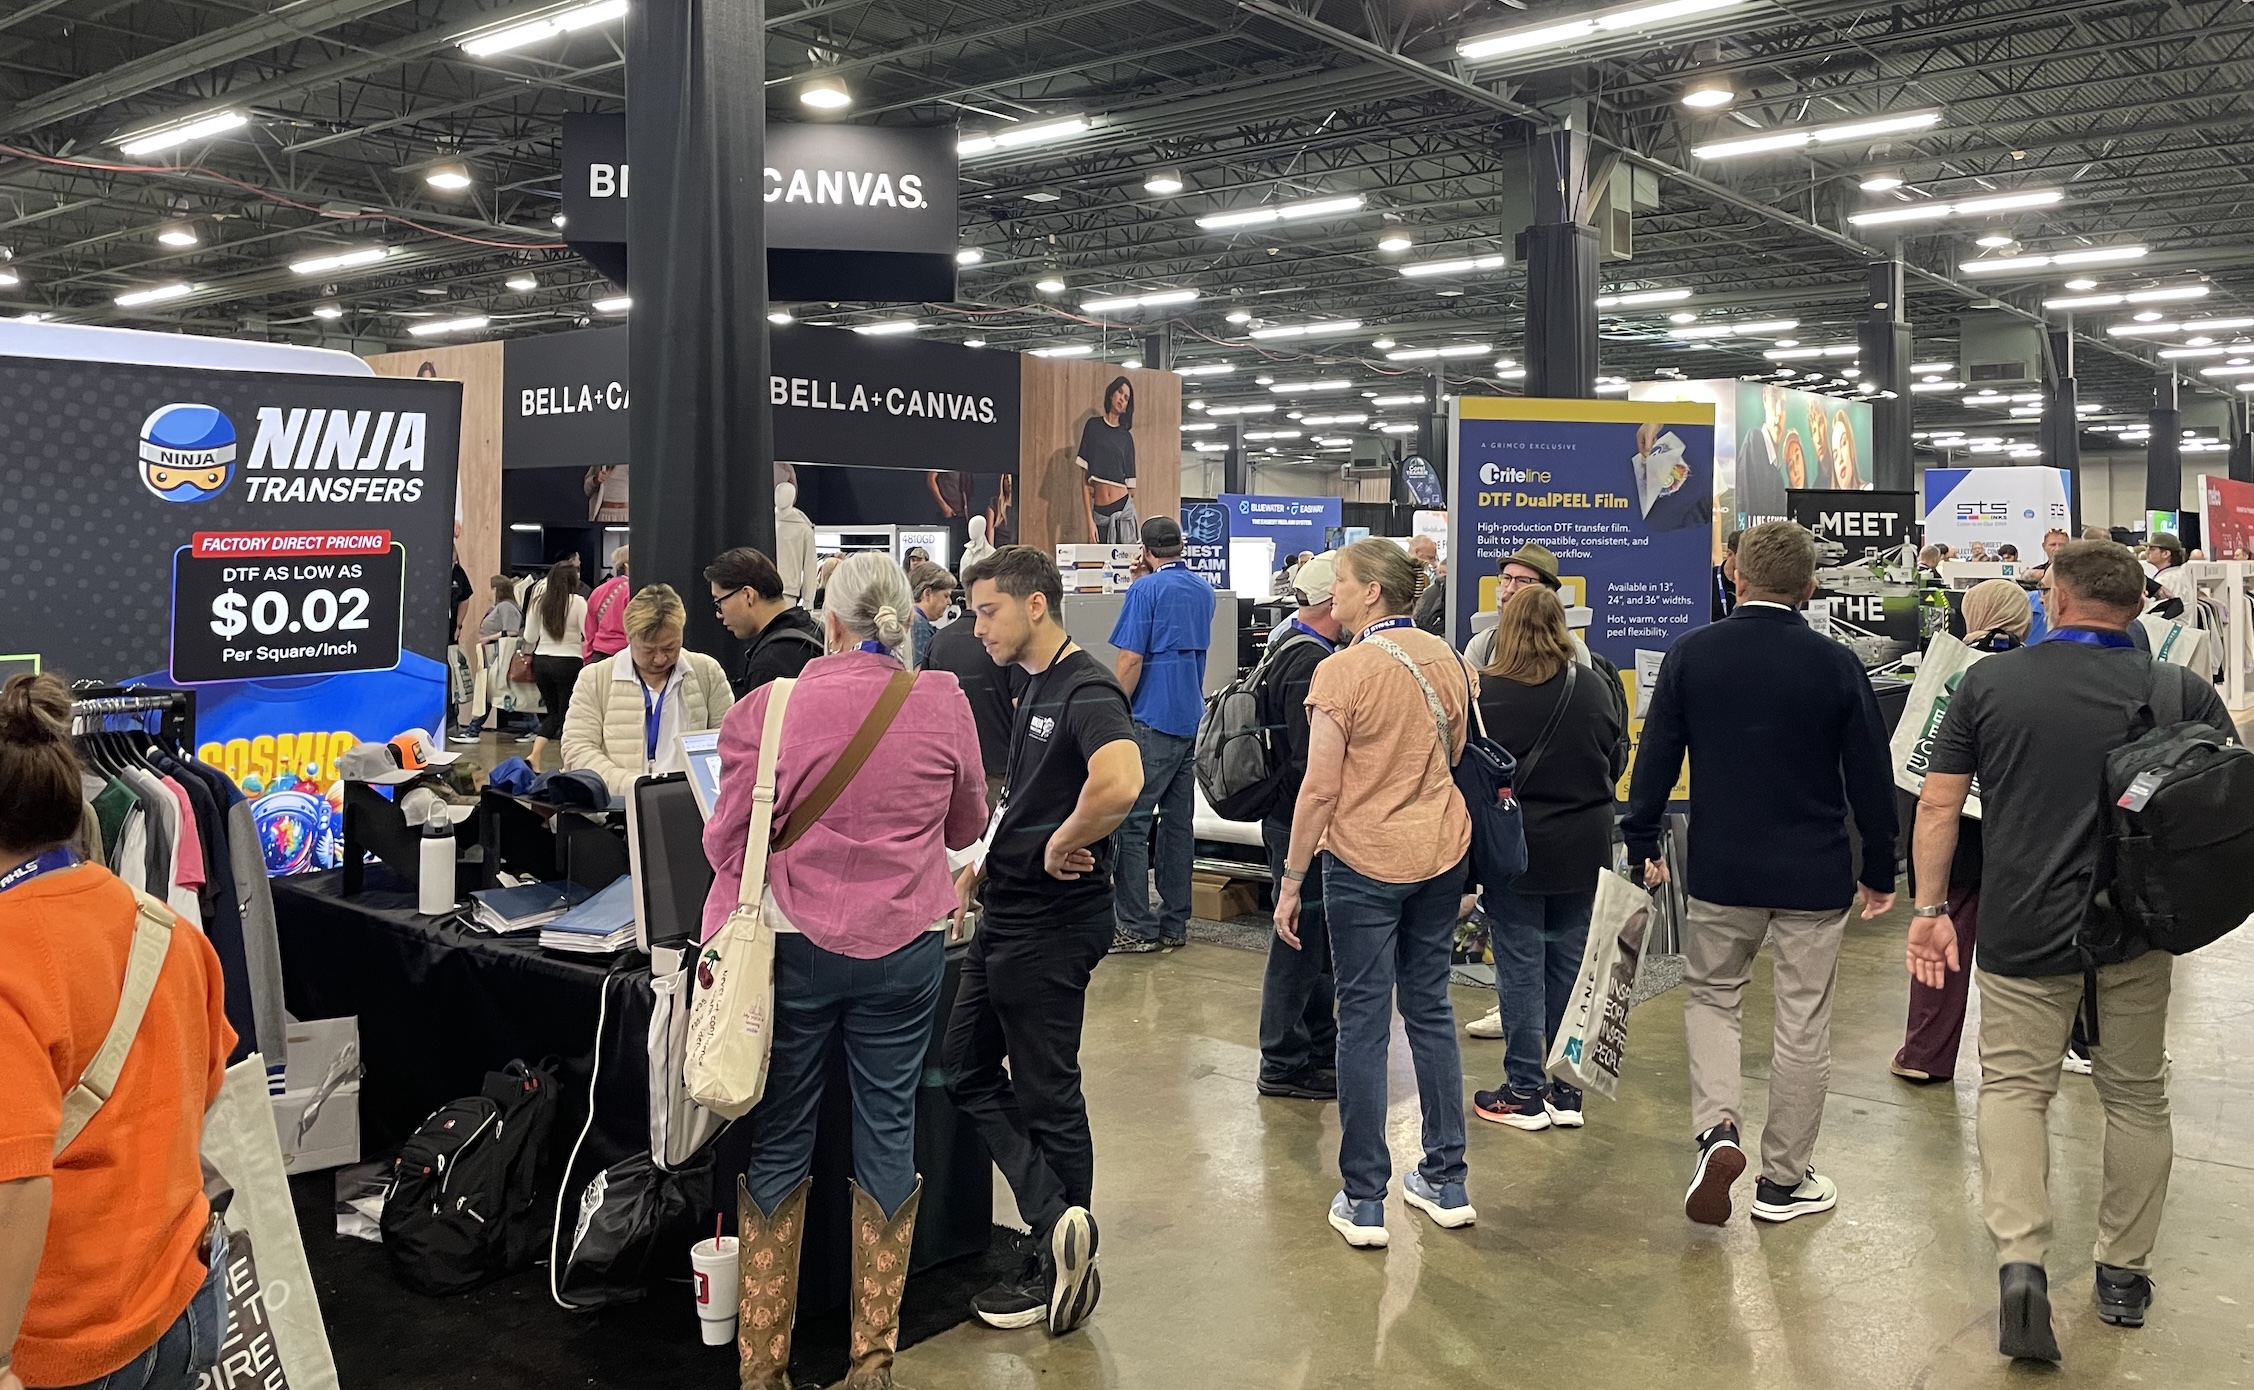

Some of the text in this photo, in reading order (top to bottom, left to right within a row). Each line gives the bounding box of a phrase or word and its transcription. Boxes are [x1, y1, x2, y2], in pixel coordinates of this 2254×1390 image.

[246, 406, 427, 471] NINJA
[160, 450, 216, 466] NINJA
[245, 476, 424, 502] TRANSFERS
[1251, 503, 1284, 512] BLUEWATER
[1478, 492, 1628, 508] DTF DualPEEL Film
[1477, 523, 1630, 533] High-production DTF transfer film.
[1820, 512, 1898, 536] MEET
[202, 535, 382, 552] FACTORY DIRECT PRICING
[1477, 536, 1648, 547] Built to be compatible, consistent, and
[1477, 550, 1510, 558] flexible
[223, 564, 362, 582] DTF AS LOW AS
[1182, 559, 1226, 571] LAIM
[1607, 582, 1647, 591] Available
[1649, 583, 1657, 591] in
[1626, 595, 1643, 604] and
[1662, 595, 1694, 605] widths.
[210, 587, 370, 641] $0.02
[1826, 597, 1885, 621] THE
[1607, 614, 1626, 624] Hot,
[1628, 616, 1656, 624] warm,
[1669, 614, 1688, 623] cold
[1606, 627, 1669, 638] peel flexibility.
[223, 641, 357, 662] Per Square/Inch
[197, 731, 360, 784] COSMIC
